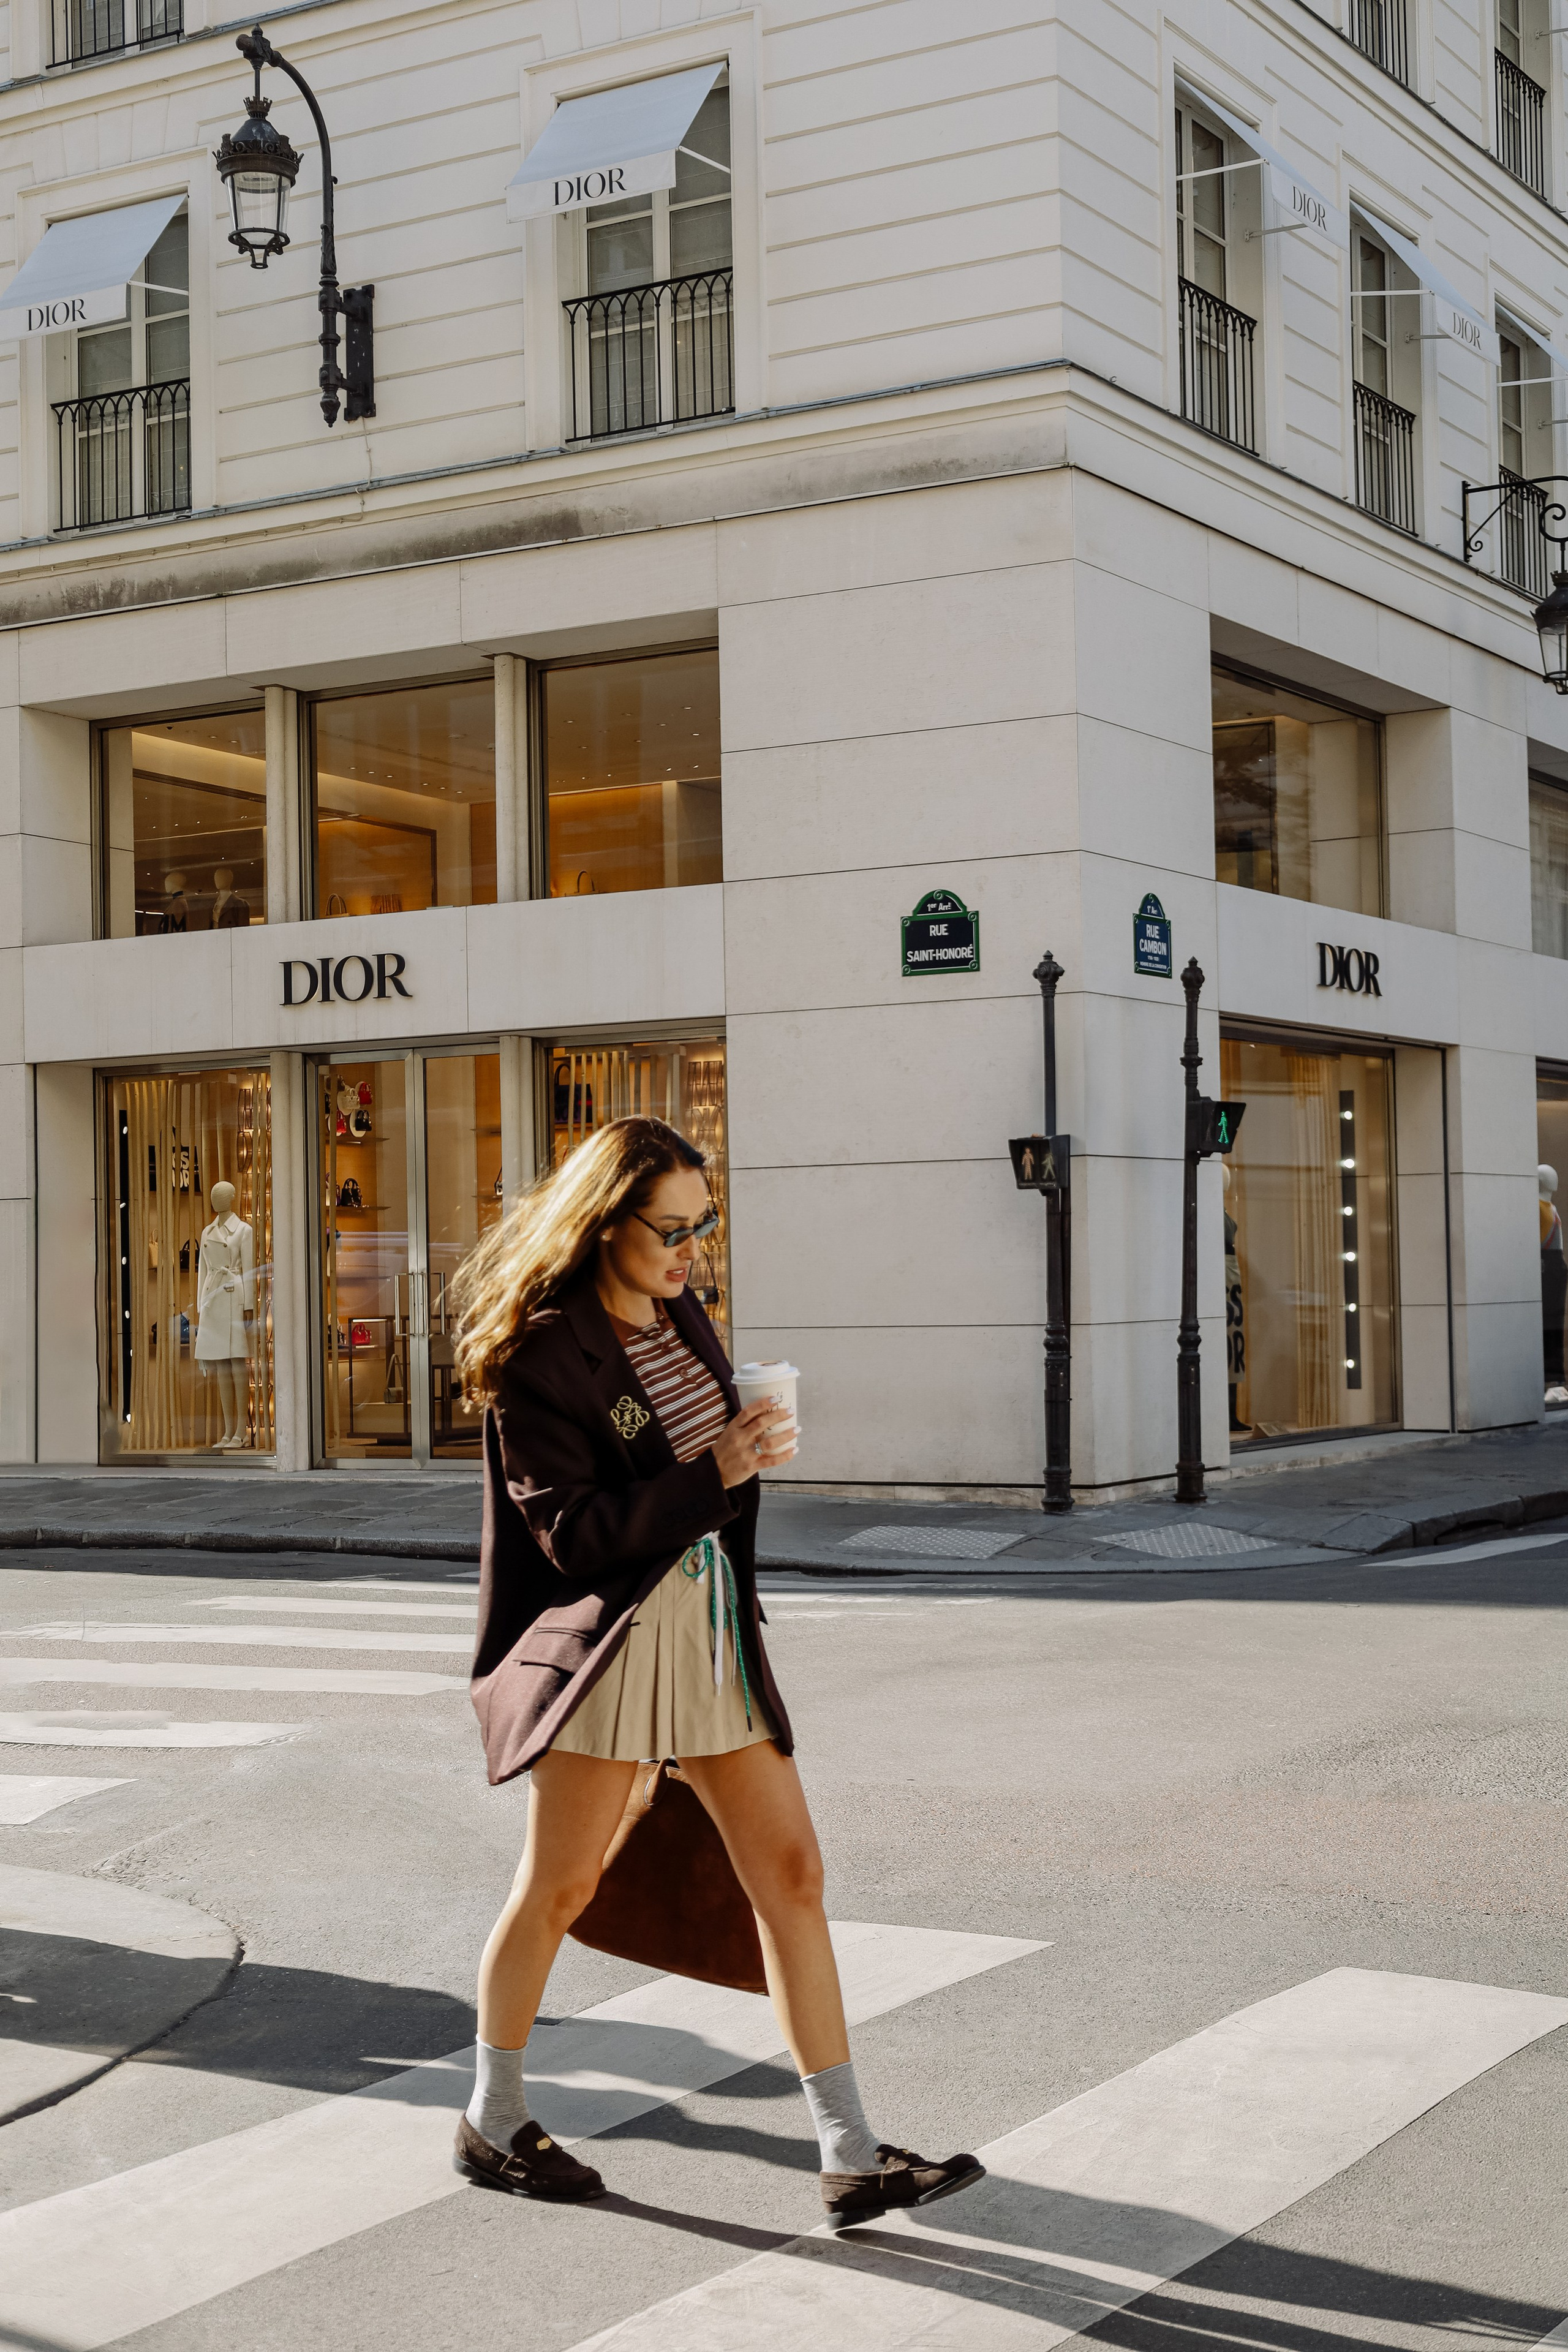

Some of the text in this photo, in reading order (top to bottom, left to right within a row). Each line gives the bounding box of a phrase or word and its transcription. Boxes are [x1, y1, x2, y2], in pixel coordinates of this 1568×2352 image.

[552, 168, 627, 206] DIOR
[1292, 186, 1327, 232] DIOR
[26, 298, 87, 331] DIOR
[1453, 312, 1482, 350] DIOR
[927, 903, 937, 912] 1er
[929, 924, 949, 937] RUE
[1139, 938, 1167, 956] CAMBON
[1146, 924, 1159, 940] RUE
[907, 943, 974, 962] SAINT-HONORÉ
[279, 953, 413, 1006] DIOR
[1316, 942, 1382, 997] DIOR
